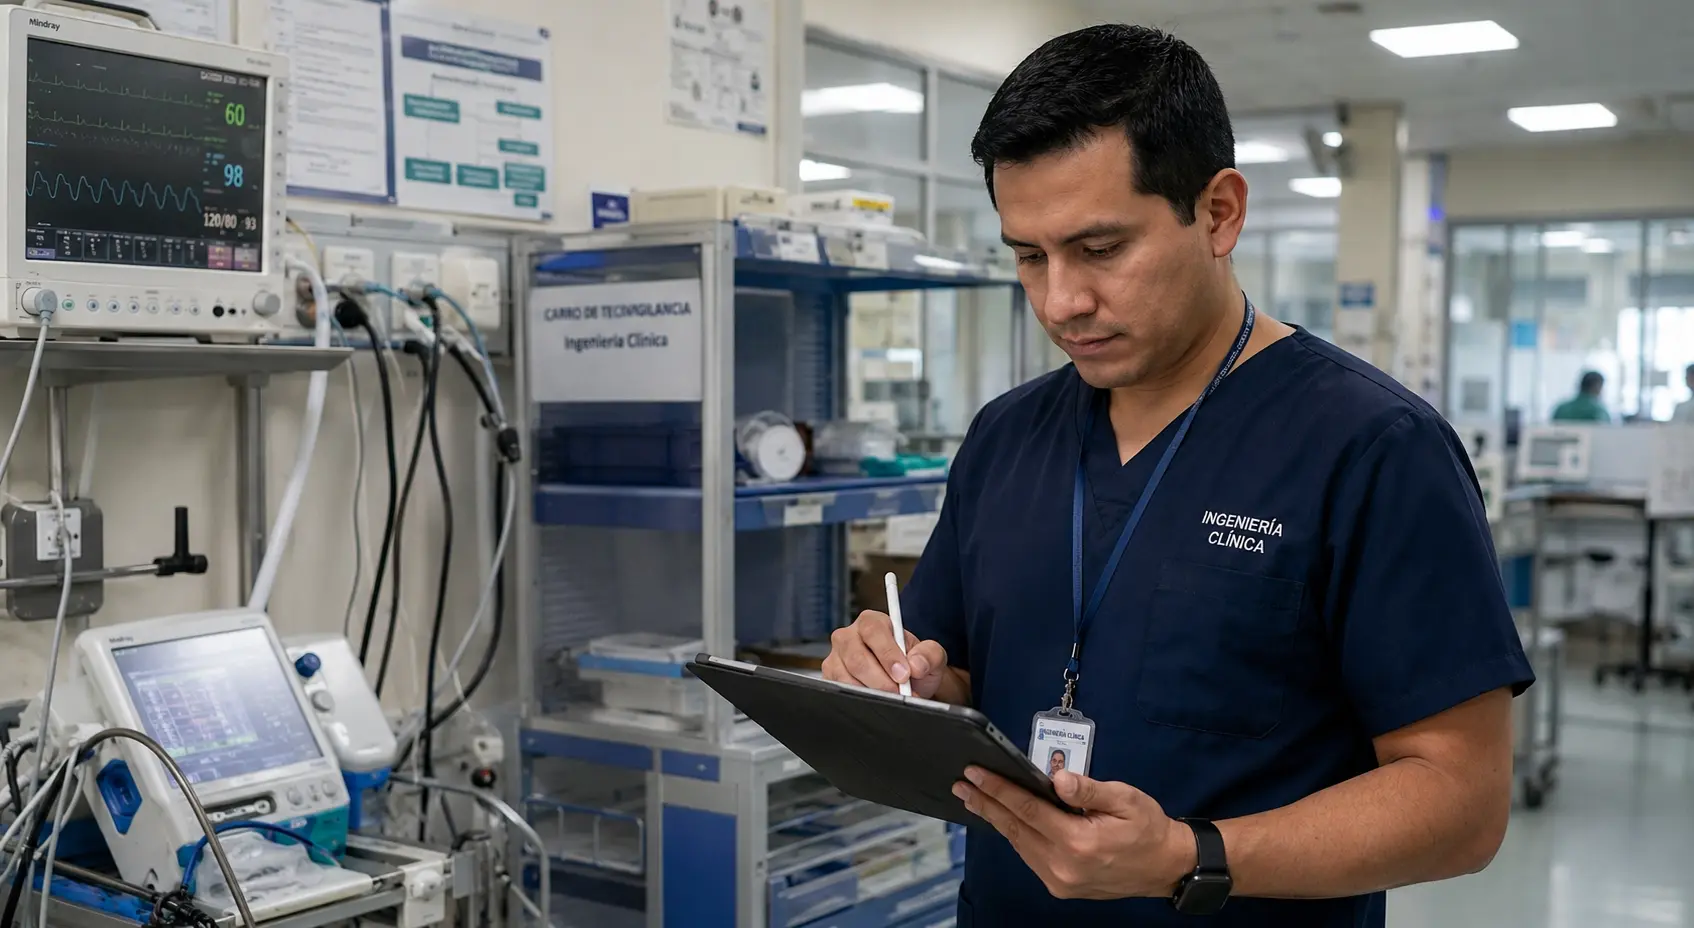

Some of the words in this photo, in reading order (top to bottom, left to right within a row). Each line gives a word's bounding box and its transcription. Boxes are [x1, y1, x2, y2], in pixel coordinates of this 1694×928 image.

[29, 18, 61, 31] Mindray
[225, 103, 245, 126] 60
[224, 163, 243, 188] 98
[204, 212, 238, 229] 120/80
[245, 216, 257, 231] 93
[544, 307, 581, 321] CARRO
[584, 305, 598, 319] DE
[1201, 510, 1283, 537] INGENIERÍA
[1208, 530, 1264, 554] CLÍNICA
